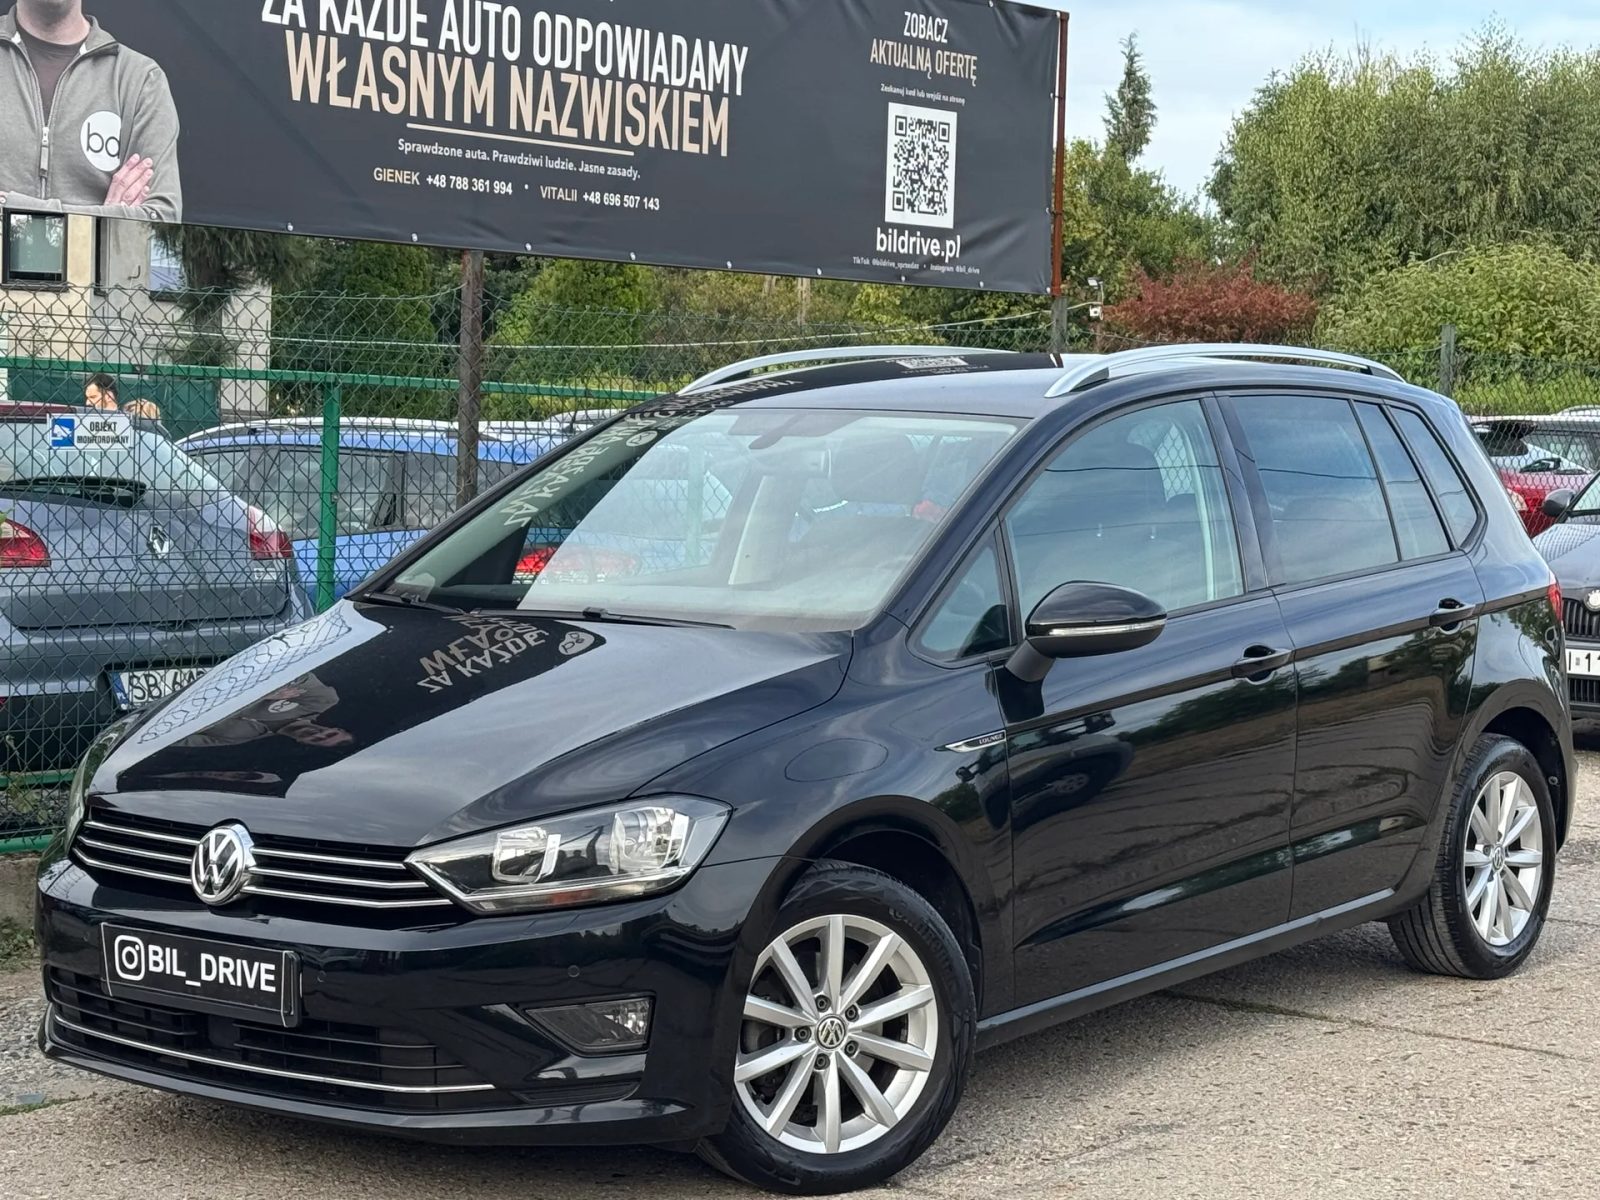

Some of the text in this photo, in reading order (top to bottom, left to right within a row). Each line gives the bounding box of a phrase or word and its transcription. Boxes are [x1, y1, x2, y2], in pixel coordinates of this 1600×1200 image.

[439, 0, 521, 61] AUTO
[533, 11, 749, 96] ODPOWIADAMY
[903, 11, 949, 44] ZOBACZ
[870, 38, 978, 87] AKTUALNĄ OFERTĘ
[285, 29, 729, 157] WŁASNYM NAZWISKIEM
[373, 167, 513, 195] GIENEK +48 788 361 994
[398, 138, 641, 181] Sprawdzone auta. Prawdziwi ludzie. Jasne zasady.
[540, 185, 660, 211] VITALII +48 696 507 143
[876, 227, 961, 263] bildrive.pl
[148, 944, 276, 993] BIL_DRIVE
